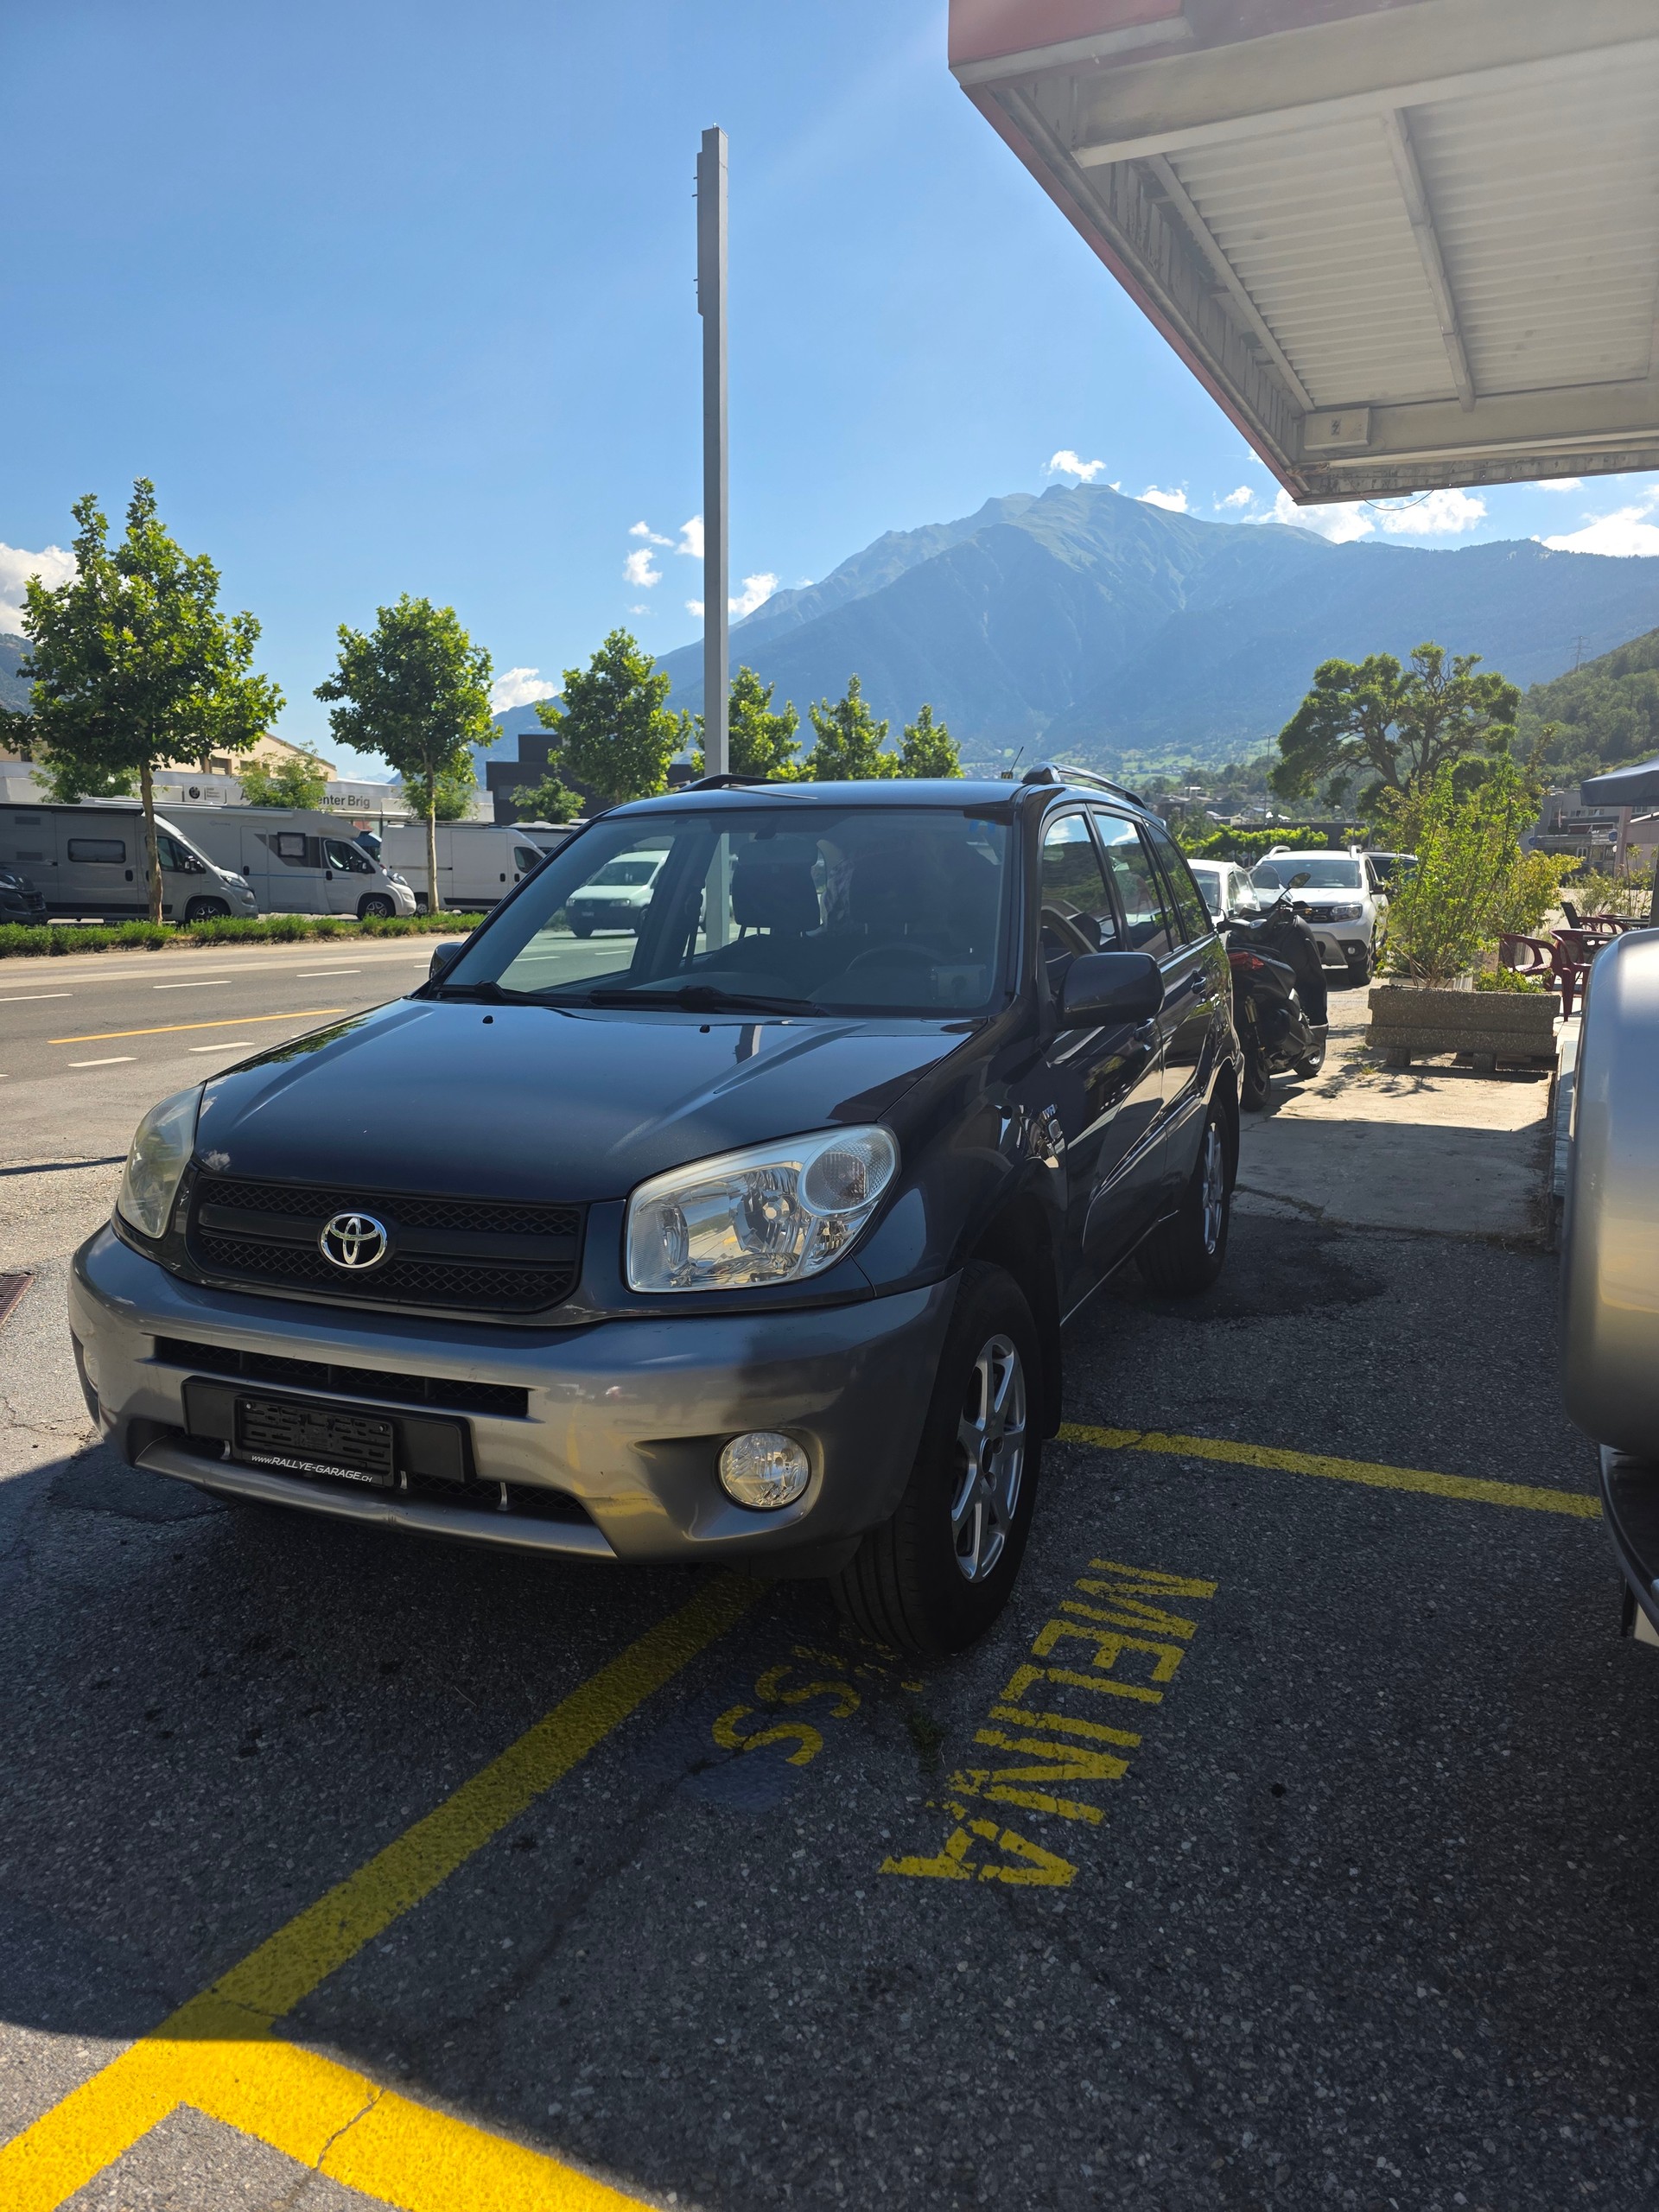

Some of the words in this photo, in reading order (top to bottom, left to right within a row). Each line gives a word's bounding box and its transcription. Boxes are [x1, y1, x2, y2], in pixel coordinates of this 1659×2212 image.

[317, 794, 346, 806] enter
[347, 795, 370, 809] Brig
[878, 1558, 1219, 1887] MELINA
